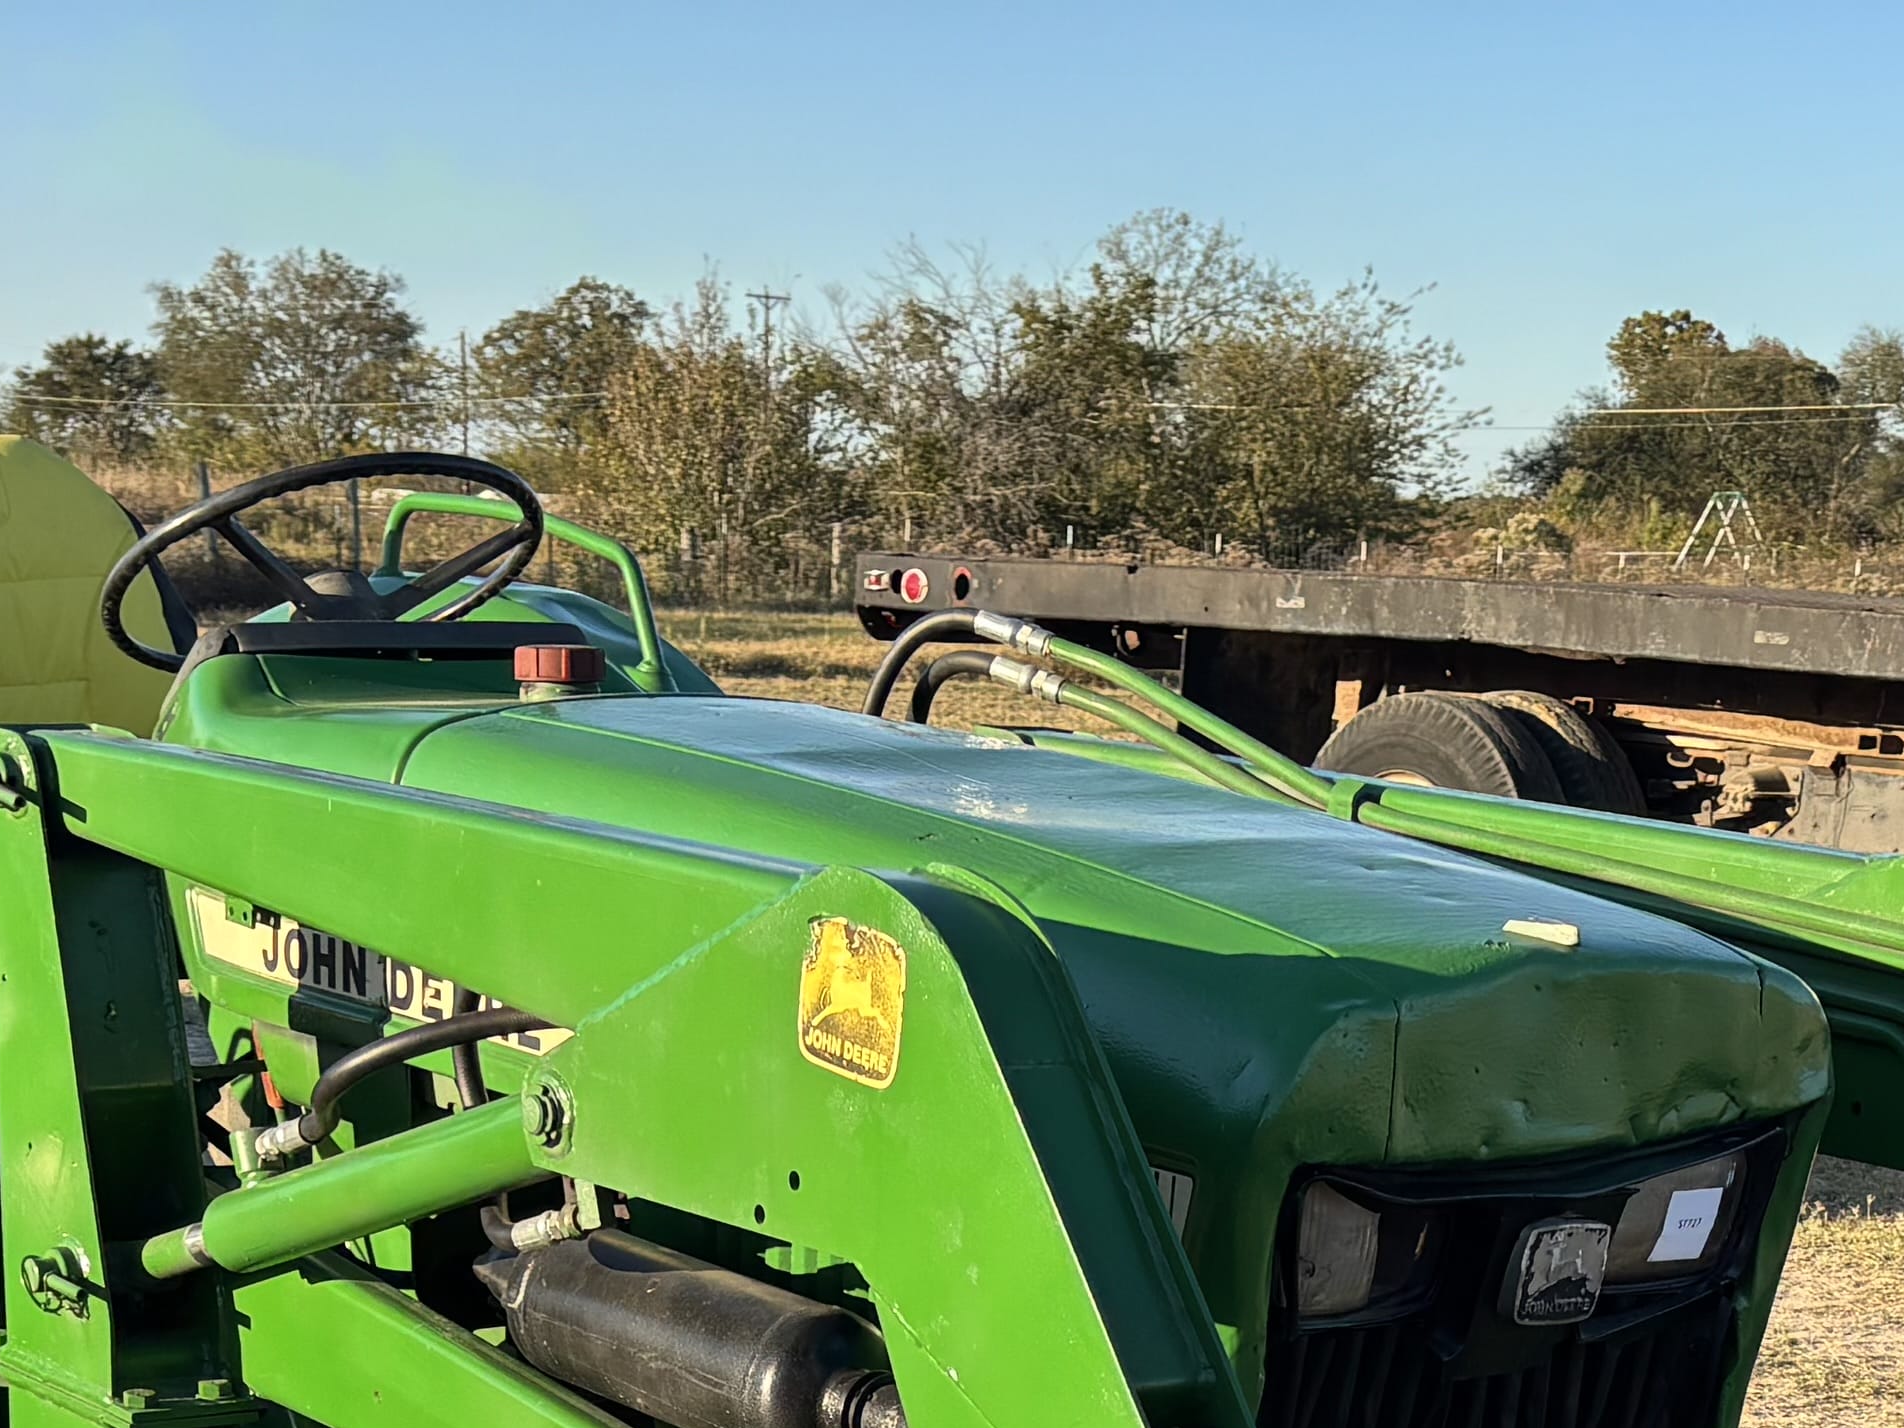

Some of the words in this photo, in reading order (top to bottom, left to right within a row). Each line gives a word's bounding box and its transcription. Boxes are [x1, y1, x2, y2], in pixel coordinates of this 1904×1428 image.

[262, 926, 367, 998] JOHN
[805, 1026, 841, 1057] JOHN
[842, 1040, 889, 1073] DEERE
